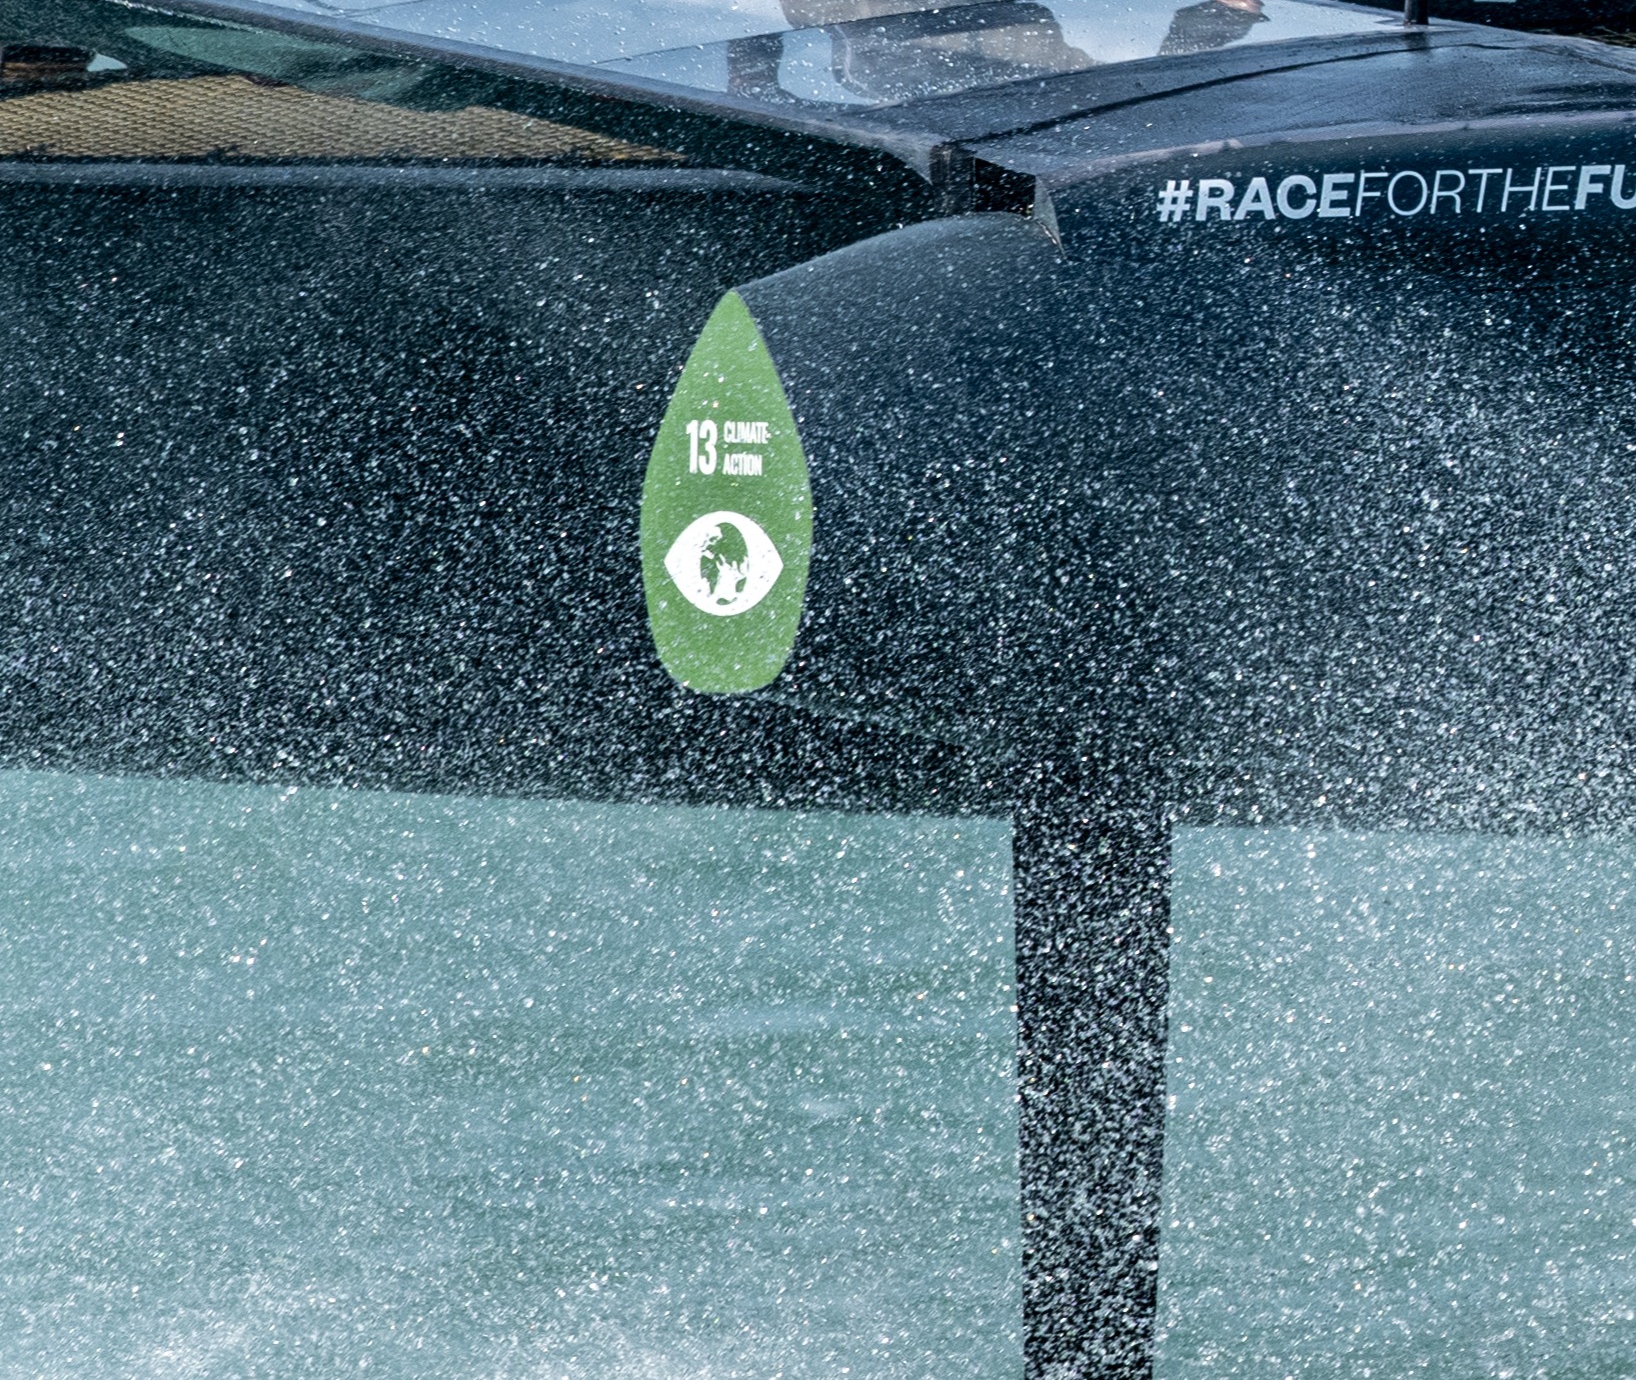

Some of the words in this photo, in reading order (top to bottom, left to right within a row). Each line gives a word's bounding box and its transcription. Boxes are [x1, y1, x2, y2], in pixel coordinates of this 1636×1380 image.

[685, 419, 719, 476] 13
[723, 420, 769, 445] CLIMATE
[722, 452, 763, 476] ACTION
